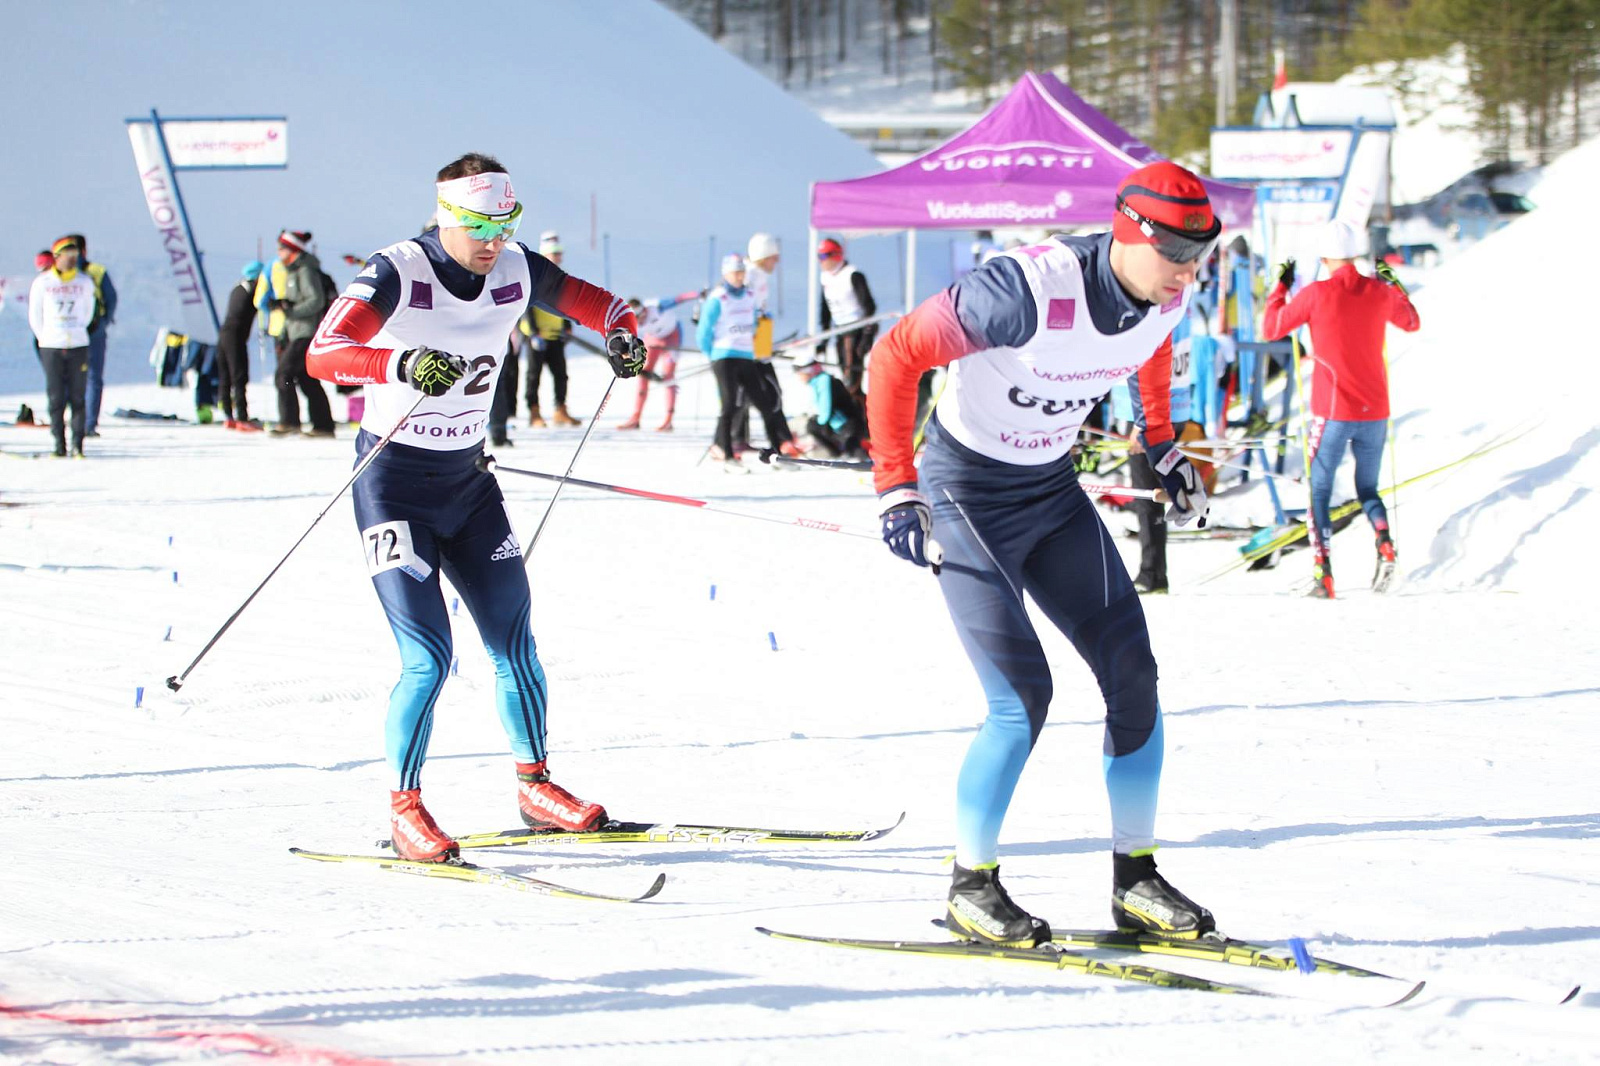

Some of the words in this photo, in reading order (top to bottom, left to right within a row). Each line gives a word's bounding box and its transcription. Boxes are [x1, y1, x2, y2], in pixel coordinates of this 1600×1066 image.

[921, 153, 1094, 171] VUOKATTI
[926, 200, 1057, 222] VuokattiSport
[142, 164, 202, 306] VUOKATTI
[369, 528, 401, 566] 72
[528, 836, 580, 846] FISCHER
[647, 823, 772, 844] FISCHER
[951, 894, 1006, 936] FISCHER
[1116, 888, 1175, 924] FISCHER
